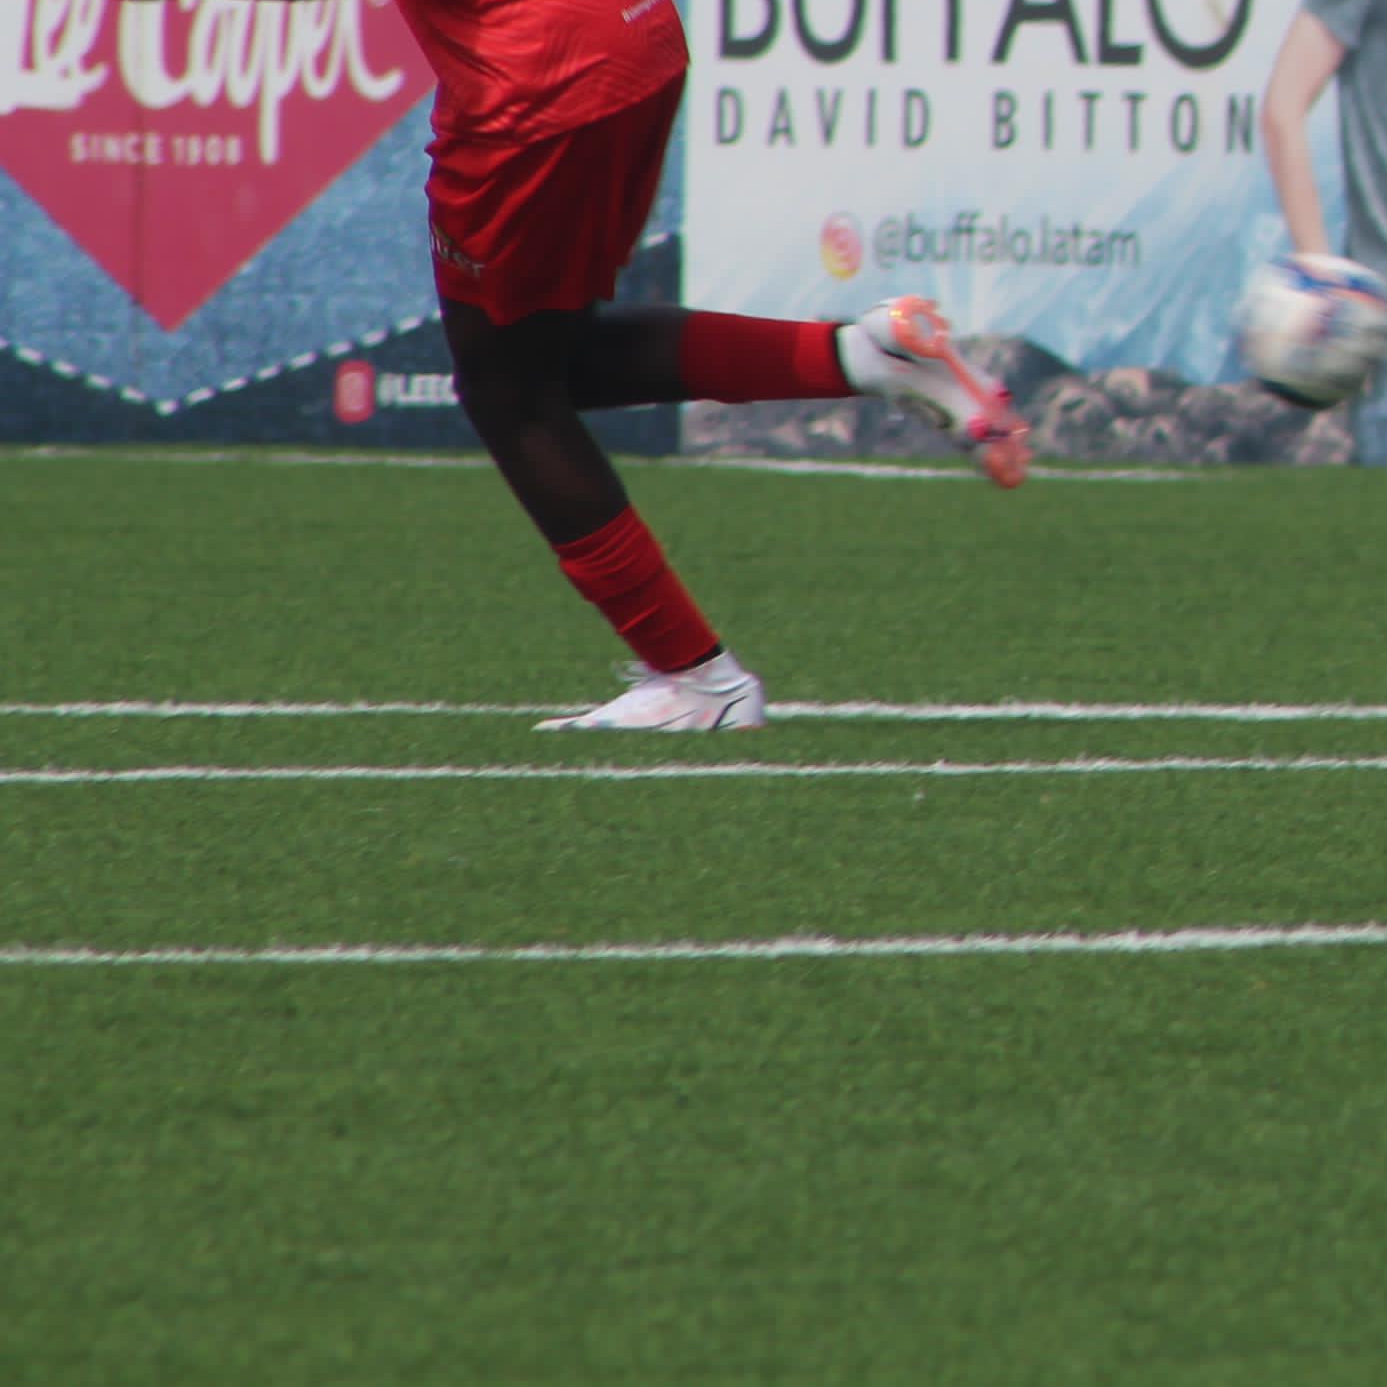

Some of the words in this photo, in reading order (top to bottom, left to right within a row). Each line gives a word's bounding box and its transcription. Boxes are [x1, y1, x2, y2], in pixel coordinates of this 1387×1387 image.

[69, 131, 163, 165] SINCE
[715, 86, 932, 149] DAVID
[991, 90, 1258, 155] BITTON
[872, 208, 1142, 270] @buffalo.latam
